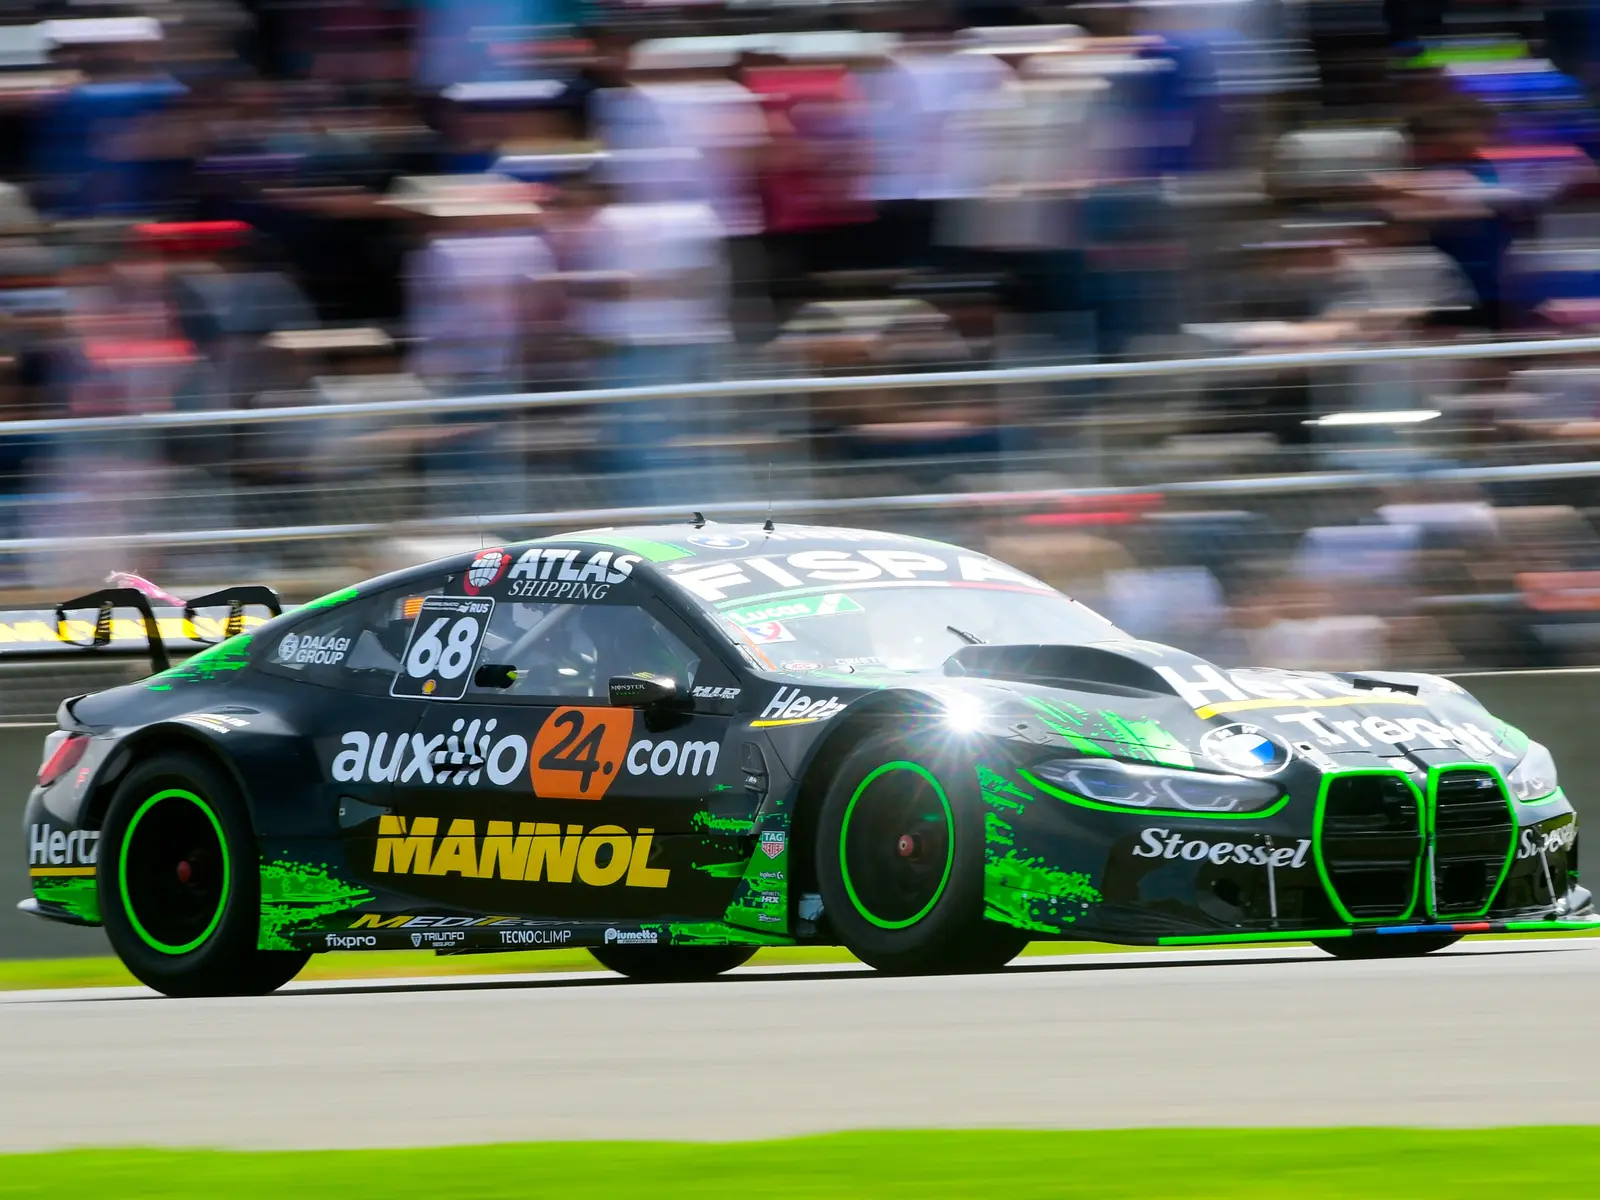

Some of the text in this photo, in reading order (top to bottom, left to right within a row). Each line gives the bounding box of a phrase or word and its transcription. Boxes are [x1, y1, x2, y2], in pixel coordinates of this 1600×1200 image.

[507, 548, 643, 584] ATLAS
[665, 550, 1058, 602] FISPA
[507, 579, 611, 600] SHIPPING
[469, 603, 490, 613] RUS
[731, 603, 812, 625] Lucas
[300, 635, 351, 651] DALAGI
[406, 616, 480, 680] 68
[296, 648, 344, 665] GROUP
[1153, 664, 1422, 708] Her
[760, 686, 848, 720] Hertz
[30, 823, 101, 865] Hertz
[764, 833, 784, 842] TAG
[1132, 827, 1312, 869] Stoessel
[373, 814, 671, 888] MANNOL
[762, 843, 785, 854] HEUER
[325, 934, 377, 948] fixpro
[422, 931, 465, 941] TRIUNFO
[500, 930, 572, 944] TECNOCLIMP
[604, 928, 658, 945] Piumetto
